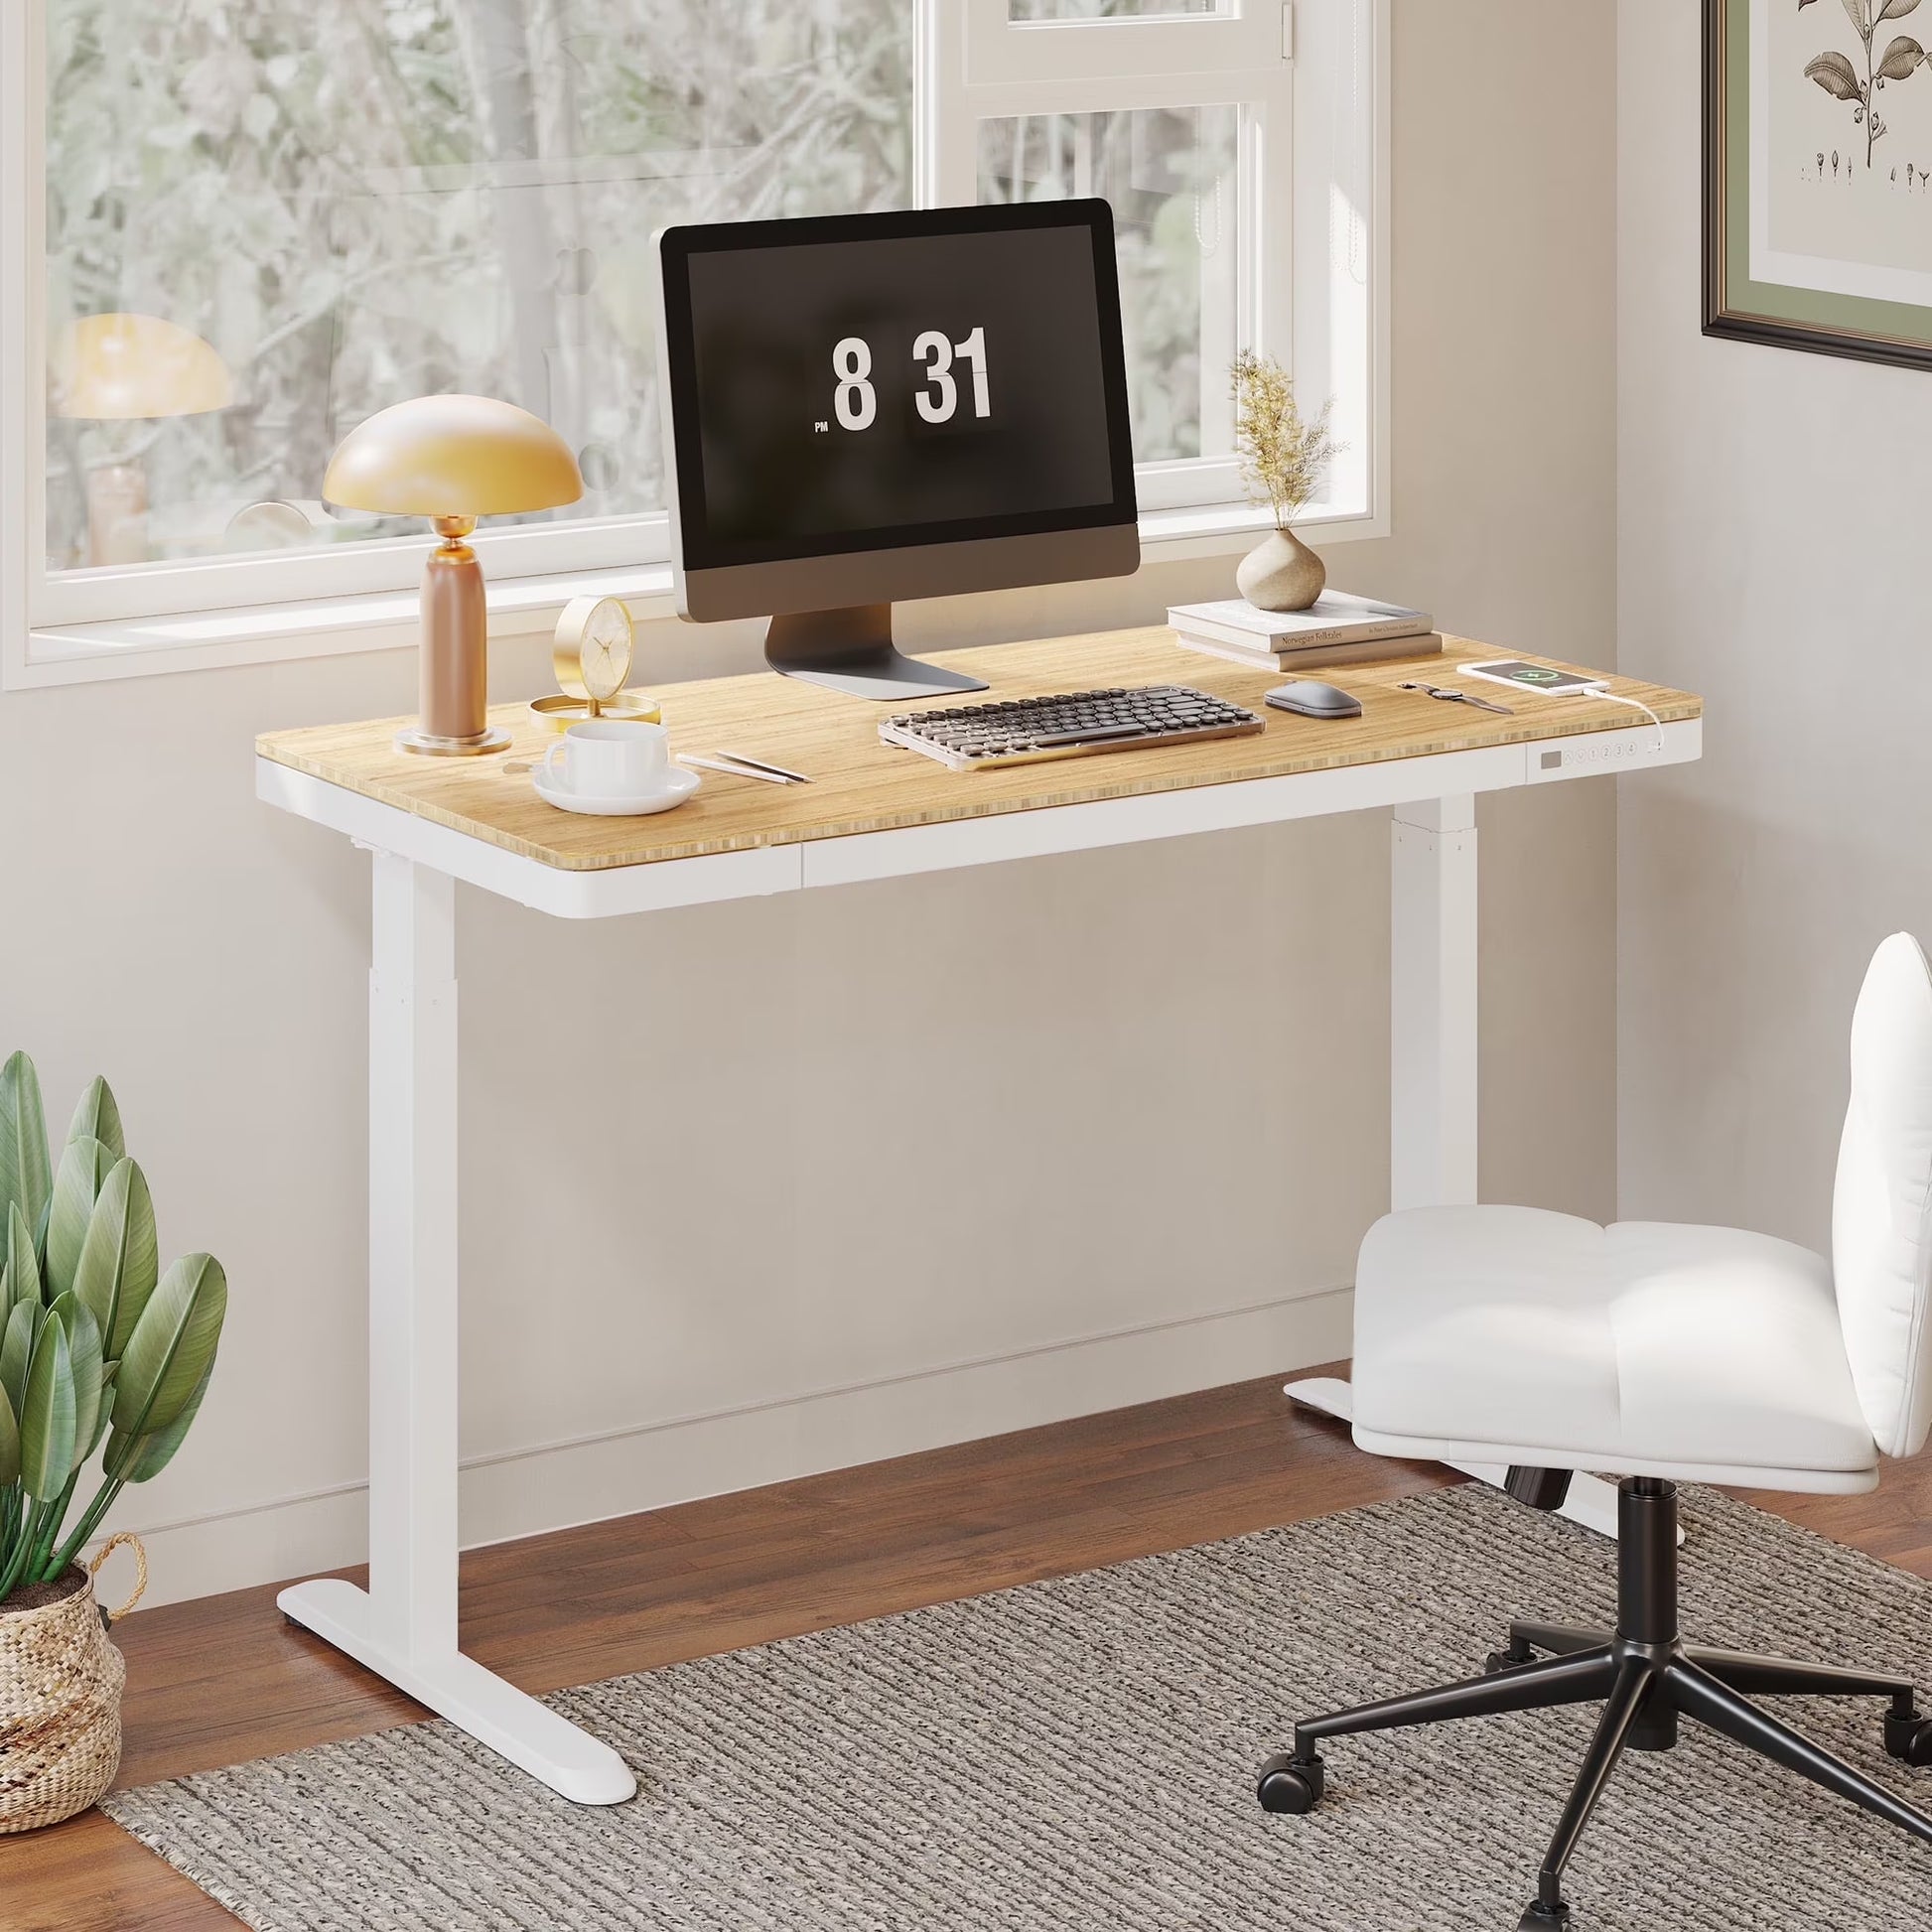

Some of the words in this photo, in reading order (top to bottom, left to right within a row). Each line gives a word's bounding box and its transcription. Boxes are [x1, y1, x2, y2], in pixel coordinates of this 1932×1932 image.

[814, 421, 829, 433] PM
[832, 337, 877, 432] 8
[912, 327, 991, 424] 31
[1282, 634, 1314, 645] Norwegian
[1315, 630, 1342, 641] Folktales
